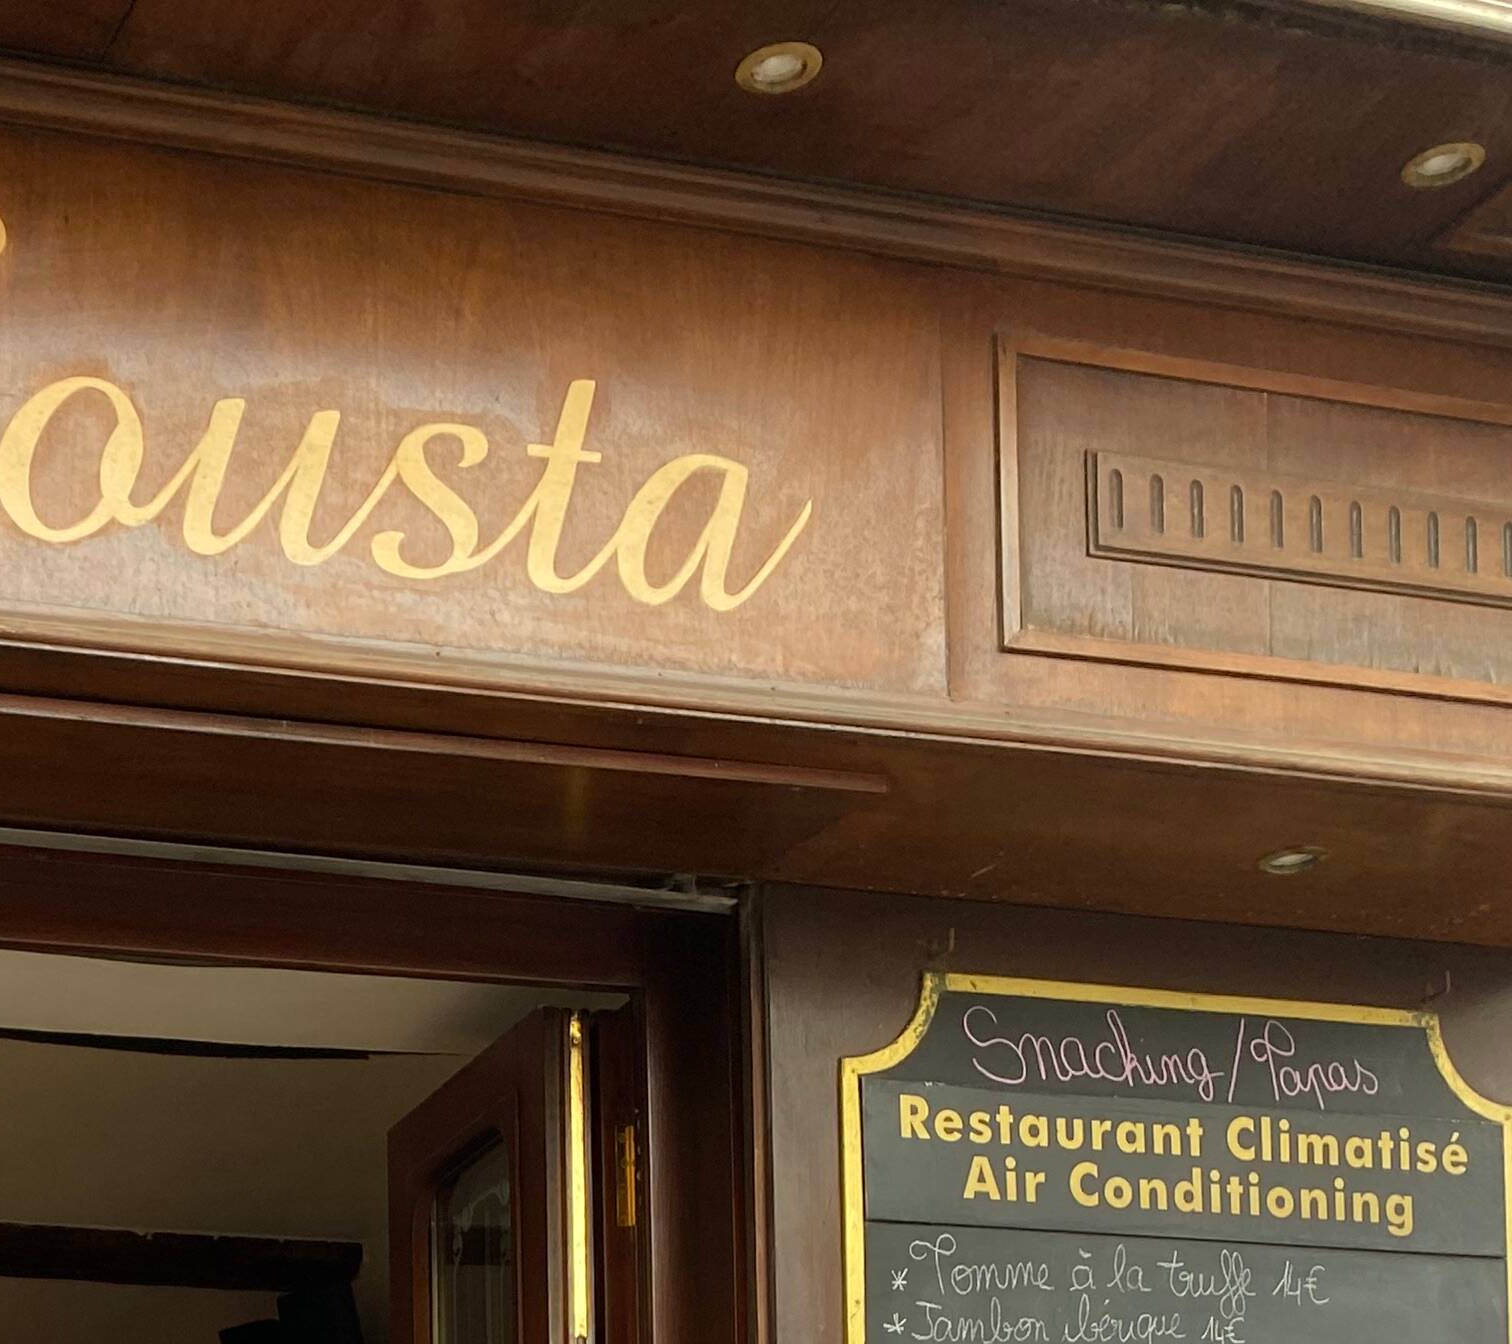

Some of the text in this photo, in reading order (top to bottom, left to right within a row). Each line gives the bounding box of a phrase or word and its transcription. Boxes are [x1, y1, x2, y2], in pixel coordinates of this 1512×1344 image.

[898, 1093, 1469, 1176] Restaurant Climatisé
[963, 1156, 1415, 1237] Air Conditioning
[909, 1234, 1054, 1295] Tomme
[1108, 1244, 1151, 1293] la
[1157, 1250, 1256, 1318] truffe
[1273, 1260, 1329, 1305] 14€
[912, 1297, 1049, 1344] Jambon
